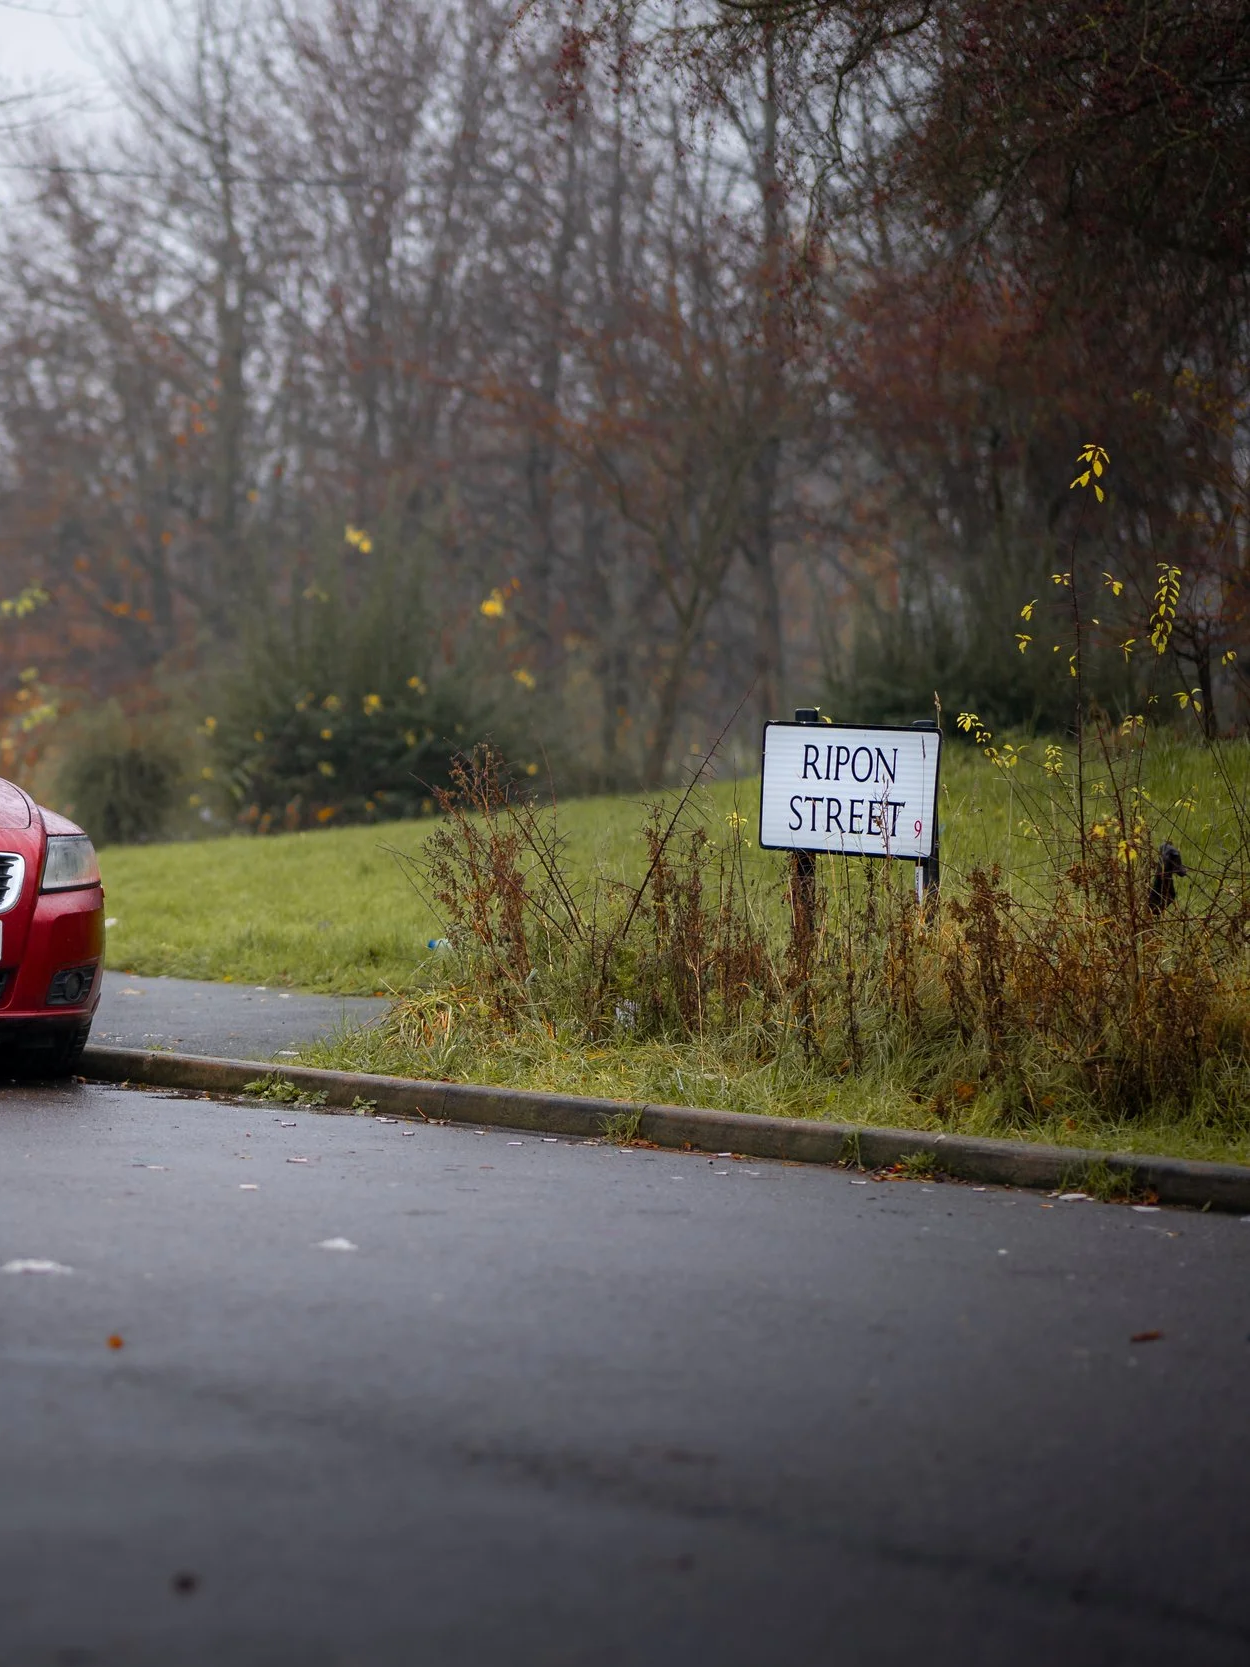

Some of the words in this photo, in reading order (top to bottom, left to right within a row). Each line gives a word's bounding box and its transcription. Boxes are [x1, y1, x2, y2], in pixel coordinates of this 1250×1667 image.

[802, 744, 898, 783] RIPON
[788, 795, 906, 837] STREET
[914, 820, 922, 839] 9
